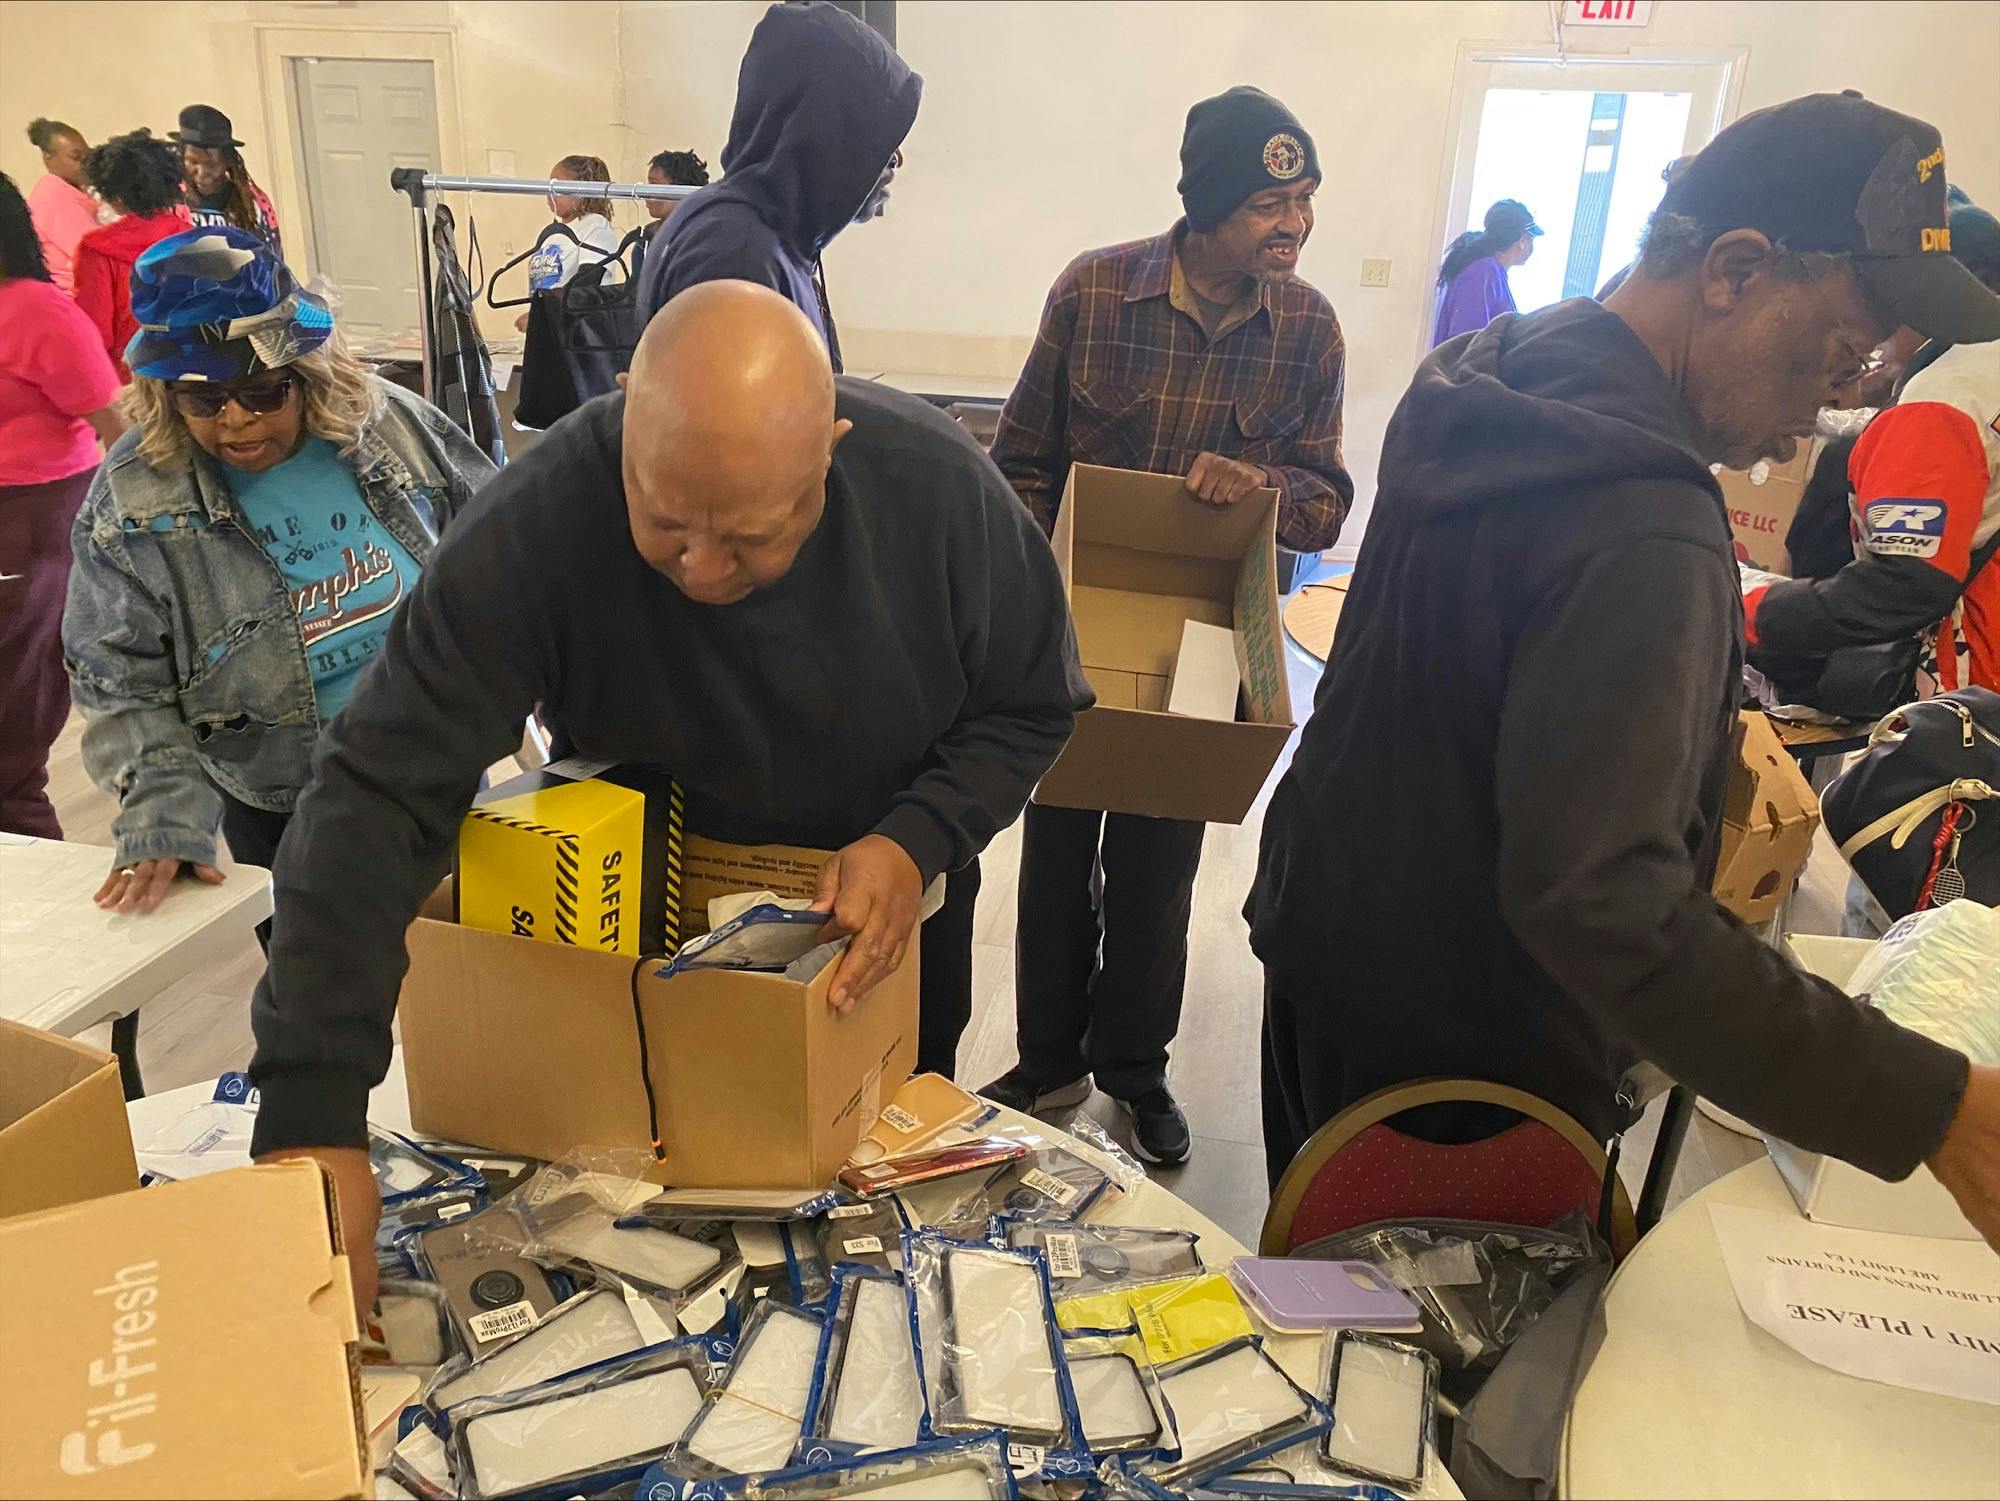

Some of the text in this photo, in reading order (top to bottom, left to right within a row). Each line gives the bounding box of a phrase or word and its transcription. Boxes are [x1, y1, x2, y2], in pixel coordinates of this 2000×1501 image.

[1752, 514, 1778, 534] LLC
[1870, 535, 1934, 548] ASON
[291, 541, 393, 620] mphis
[1766, 1255, 1846, 1274] CURTAINS
[1848, 1269, 1880, 1281] AND
[1883, 1276, 1943, 1296] LINENS
[1946, 1289, 1980, 1302] BED
[519, 1317, 532, 1326] For
[1785, 1303, 1913, 1337] PLEASE
[1945, 1330, 2000, 1355] MIT
